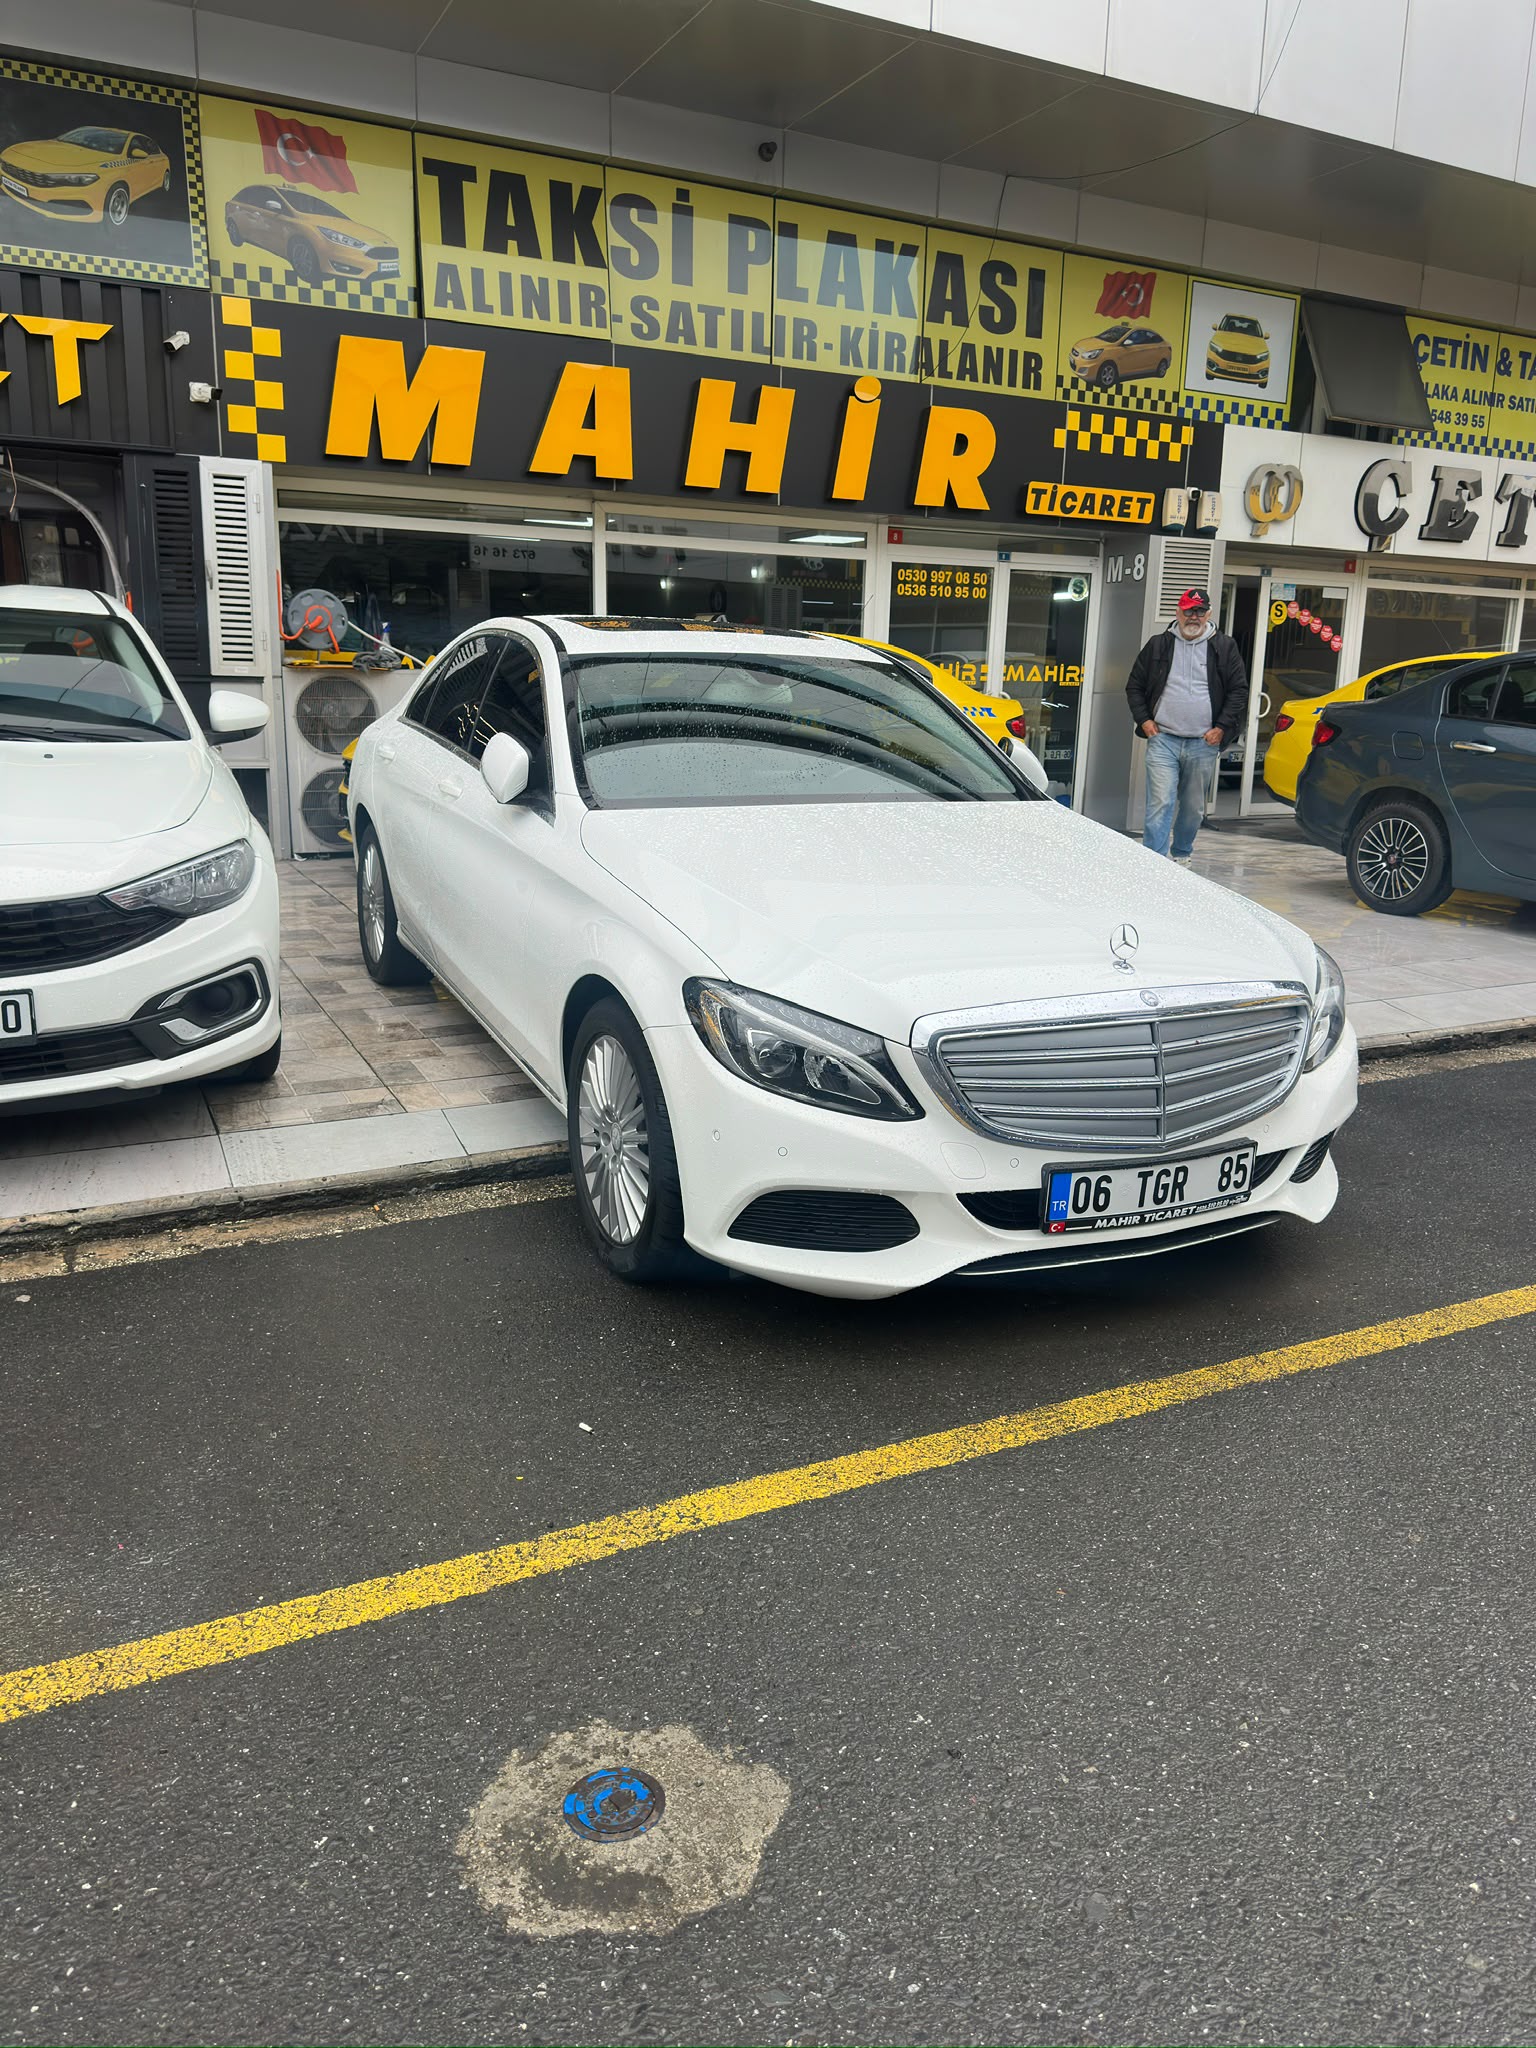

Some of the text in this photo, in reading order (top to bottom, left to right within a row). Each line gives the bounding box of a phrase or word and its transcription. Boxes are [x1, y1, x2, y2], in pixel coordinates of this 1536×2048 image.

[421, 156, 1047, 340] TAKSİ PLAKASI
[0, 312, 115, 406] T
[1412, 332, 1490, 374] ÇETİN
[1496, 346, 1513, 378] &
[1423, 381, 1536, 415] LAKA ALINIR SATI
[325, 334, 997, 511] MAHİR
[1454, 411, 1469, 427] 39
[1471, 414, 1485, 429] 55
[1030, 484, 1152, 520] TİCARET
[897, 568, 988, 586] 0530 997 08 50
[1105, 552, 1146, 584] M-8
[896, 583, 987, 599] 0536 510 95 00
[1274, 603, 1283, 618] S
[939, 661, 977, 682] HİR
[1004, 663, 1081, 683] MAHİR
[1052, 1152, 1250, 1215] TR 06 TGR 85
